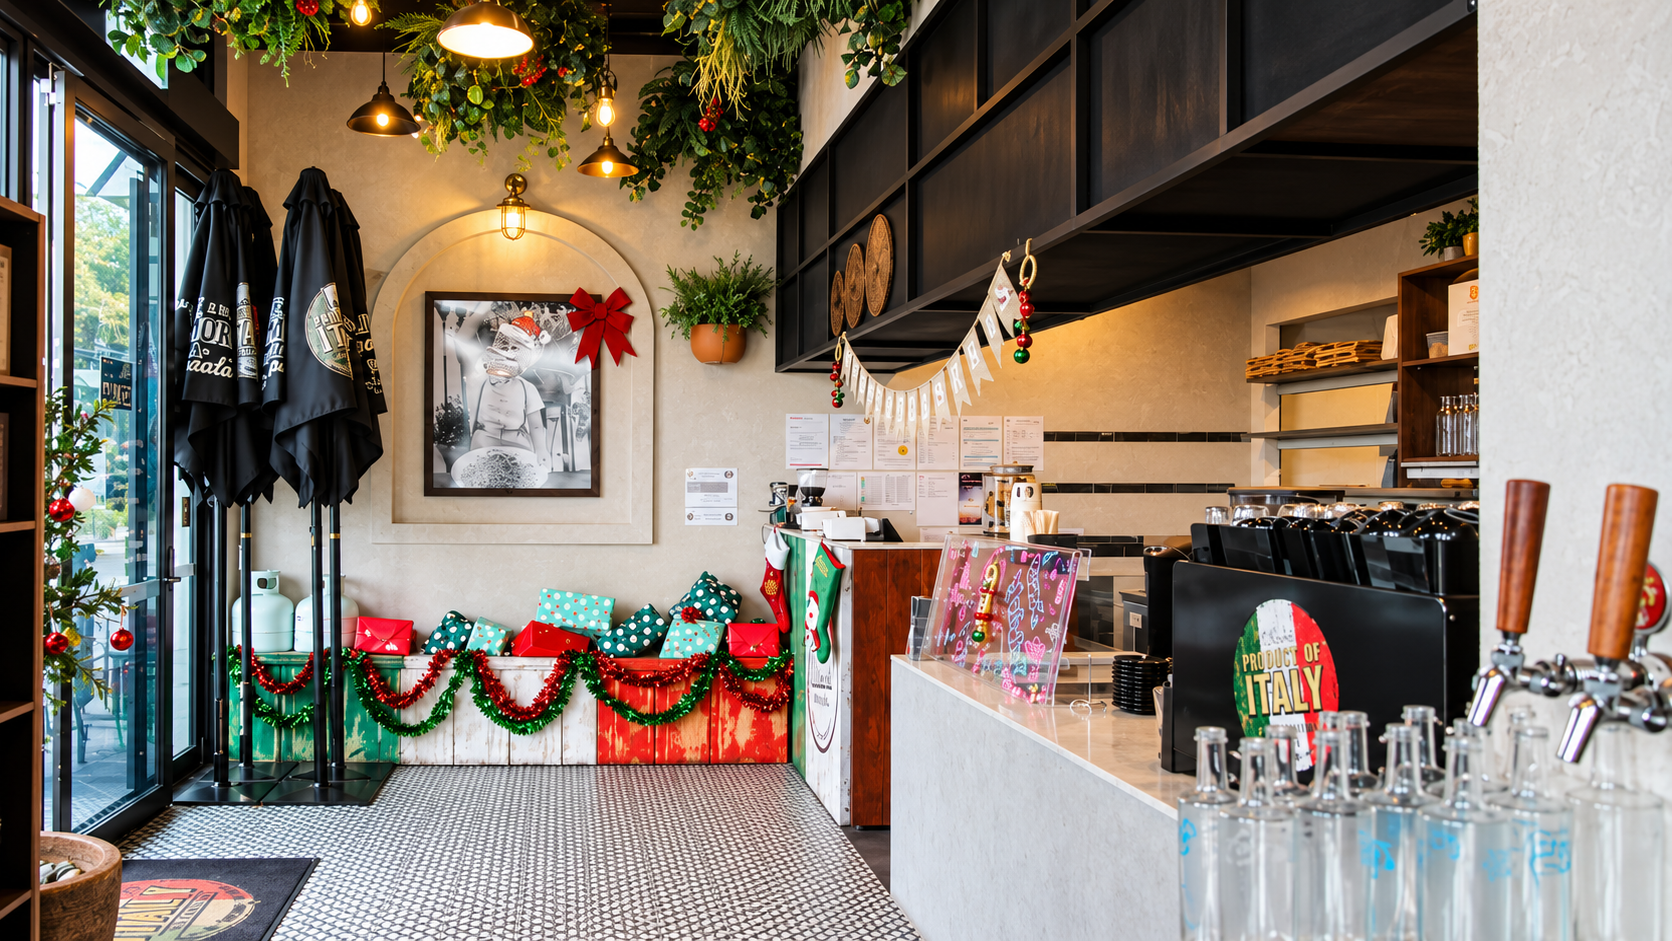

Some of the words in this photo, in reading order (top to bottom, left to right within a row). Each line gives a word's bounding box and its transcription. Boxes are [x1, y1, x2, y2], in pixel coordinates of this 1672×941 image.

[1242, 646, 1298, 672] PRODUCT
[1304, 642, 1321, 663] OF
[1244, 665, 1323, 717] ITALY
